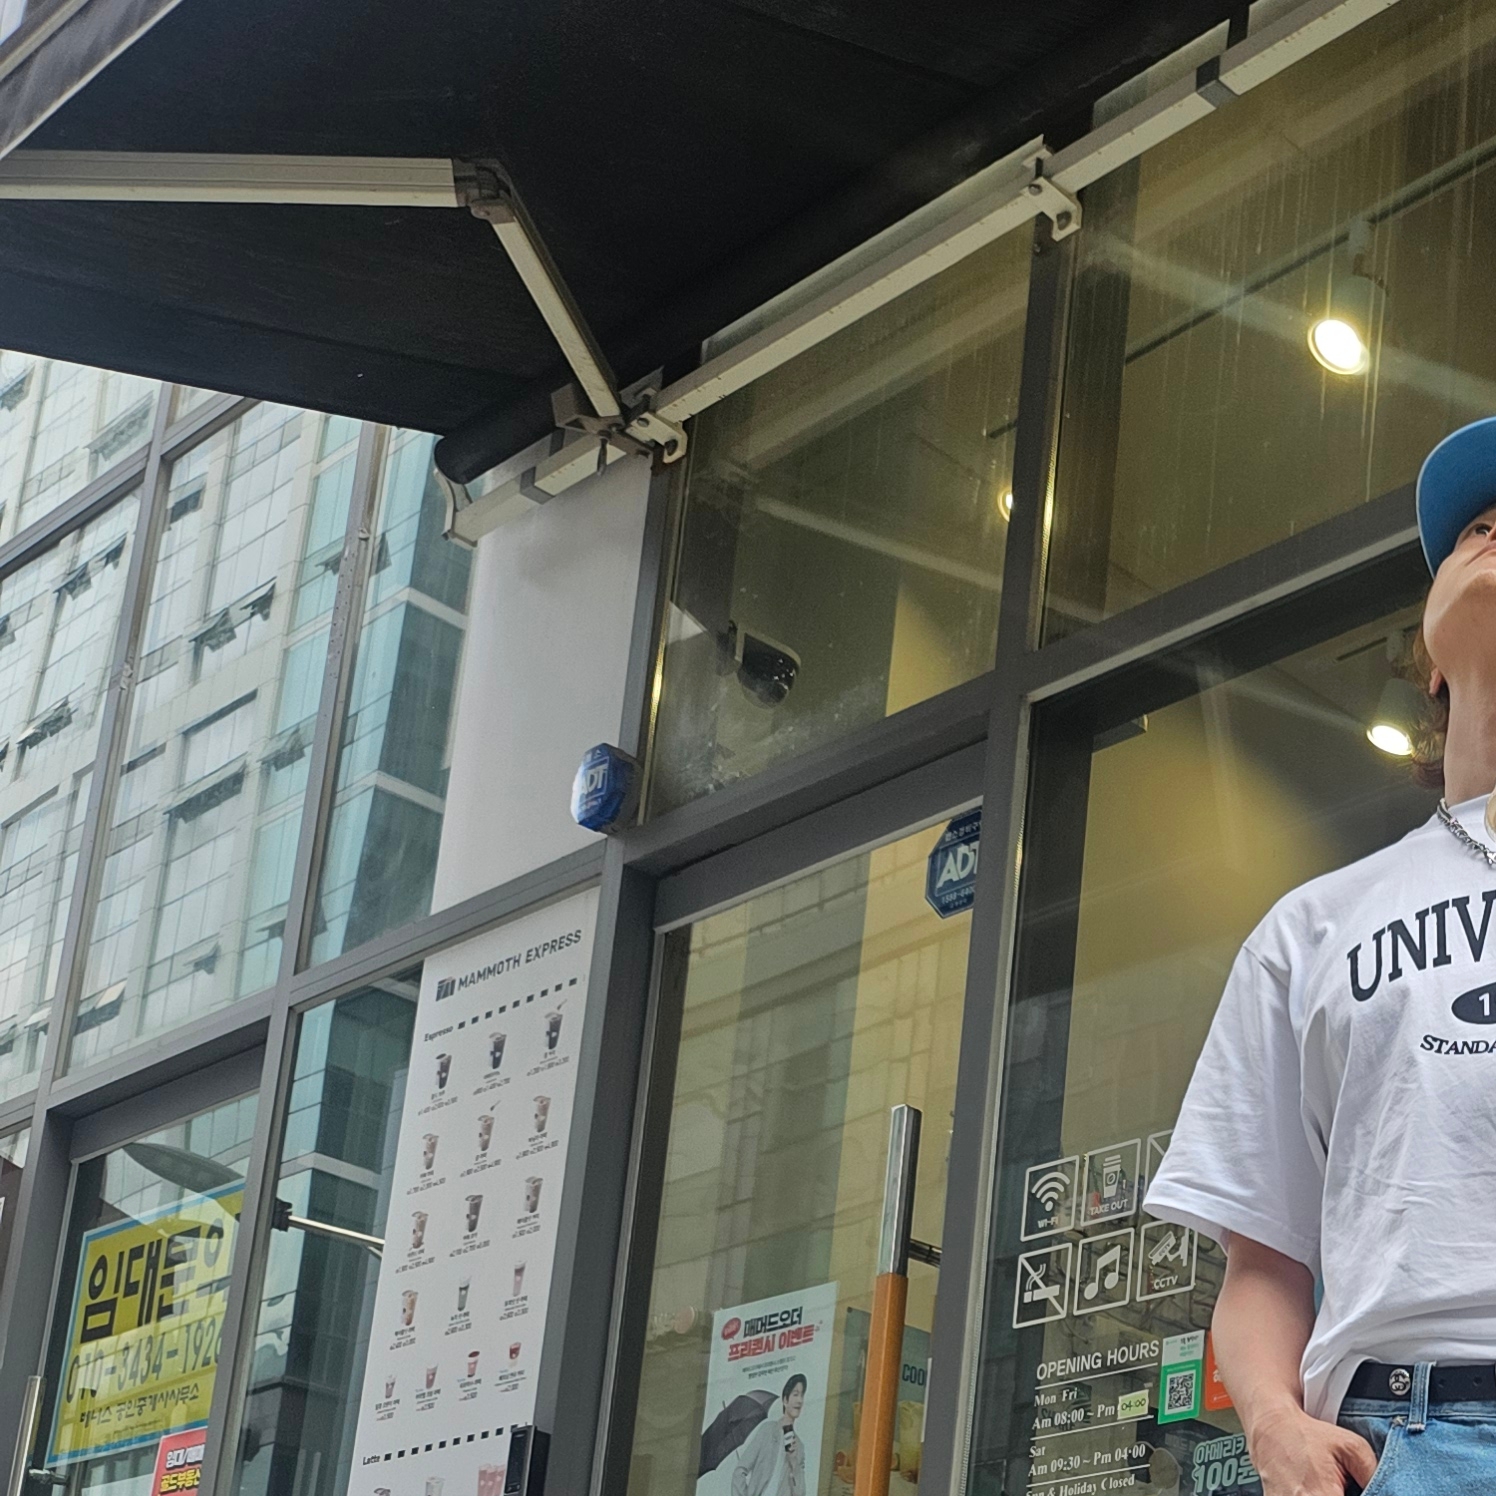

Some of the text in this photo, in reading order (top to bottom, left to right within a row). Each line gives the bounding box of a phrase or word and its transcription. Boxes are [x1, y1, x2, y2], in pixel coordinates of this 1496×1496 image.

[935, 840, 981, 889] ADT
[457, 929, 582, 992] MAMMOTH EXPRESS
[423, 1025, 454, 1043] Espresso
[1090, 1199, 1129, 1216] TAKE OUT
[1153, 1275, 1179, 1290] CCTV
[743, 1305, 804, 1338] 매머드오더
[778, 1323, 816, 1351] 이벤트
[1036, 1351, 1102, 1381] OPENING
[1106, 1340, 1160, 1368] HOURS
[1033, 1386, 1078, 1408] Mon Fri
[1120, 1397, 1147, 1412] 04:00
[1031, 1405, 1116, 1431] Am 08:00 Pm
[362, 1453, 381, 1466] Latte
[1027, 1443, 1146, 1478] Am 09:30 Pm 04:00
[1028, 1444, 1046, 1458] Sat
[1101, 1474, 1135, 1491] Closed
